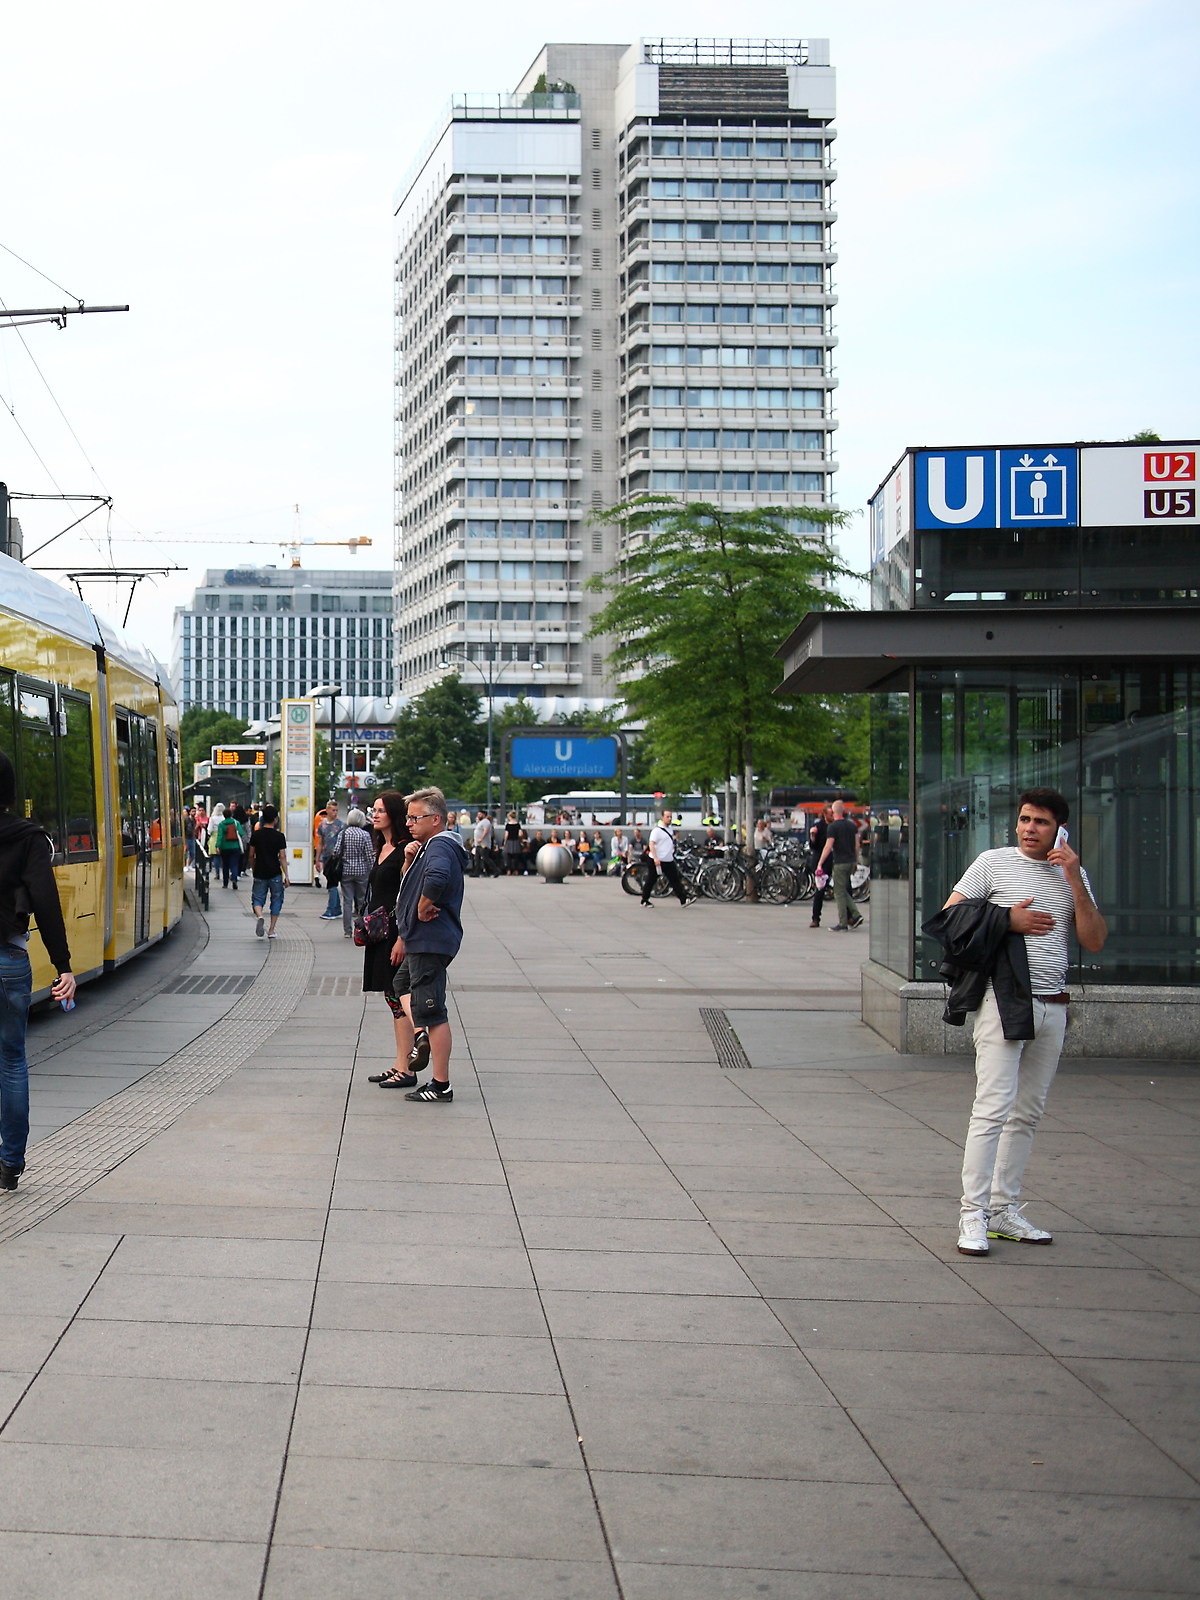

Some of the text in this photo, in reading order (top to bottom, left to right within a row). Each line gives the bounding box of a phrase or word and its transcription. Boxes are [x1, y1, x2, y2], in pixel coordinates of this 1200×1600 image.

[1150, 455, 1191, 478] U2
[928, 456, 984, 524] U
[1150, 491, 1191, 515] U5
[555, 740, 572, 761] U
[523, 763, 604, 776] Alexanderplatz
